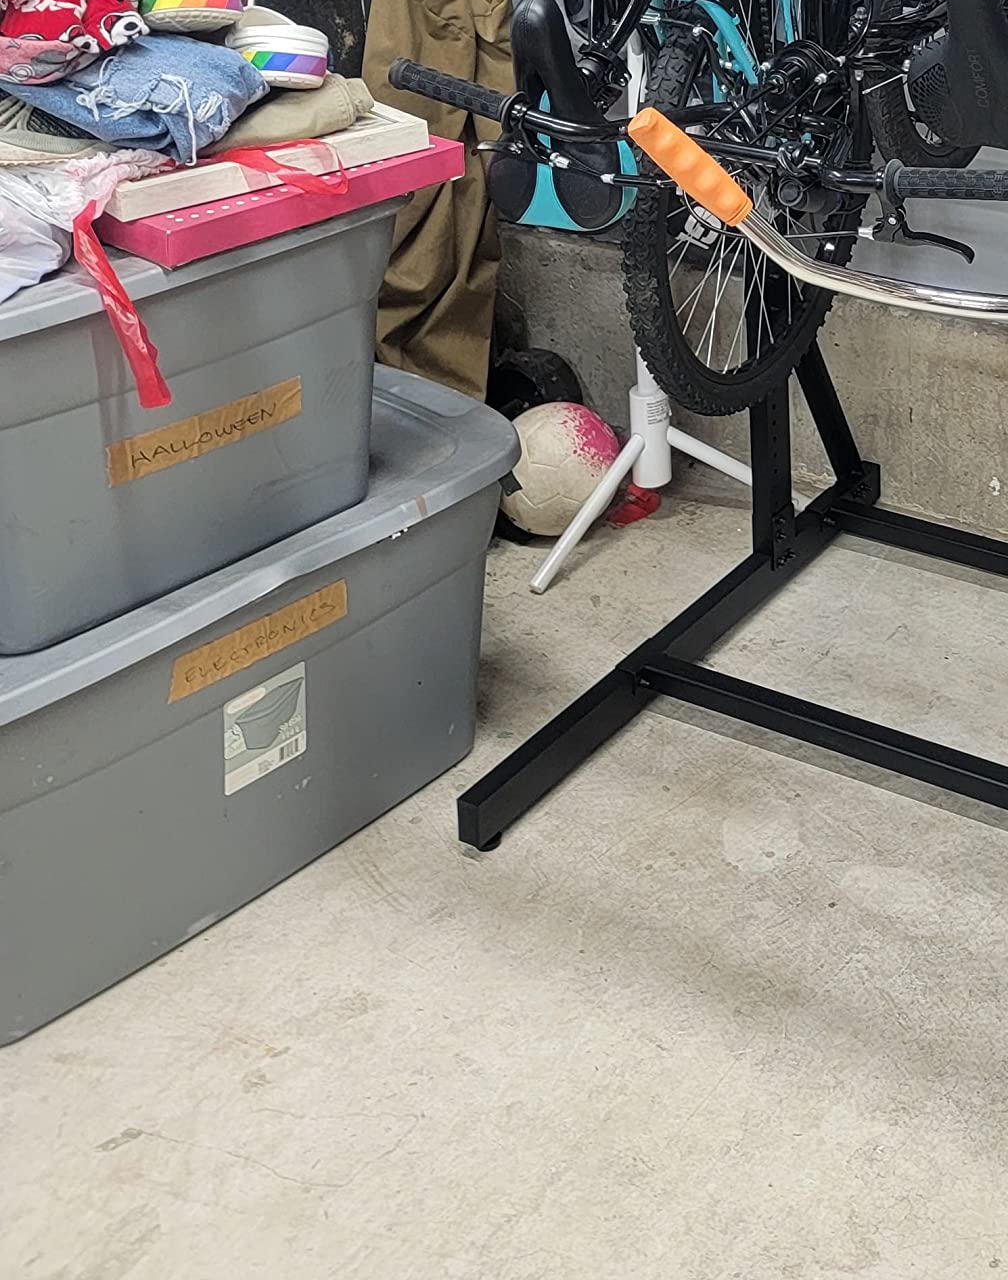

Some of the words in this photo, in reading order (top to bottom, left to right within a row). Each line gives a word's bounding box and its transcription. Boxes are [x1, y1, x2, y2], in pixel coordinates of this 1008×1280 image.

[966, 48, 989, 108] COMFORT
[130, 402, 278, 469] HALLOWEEN
[184, 601, 337, 684] ELECTRONICS
